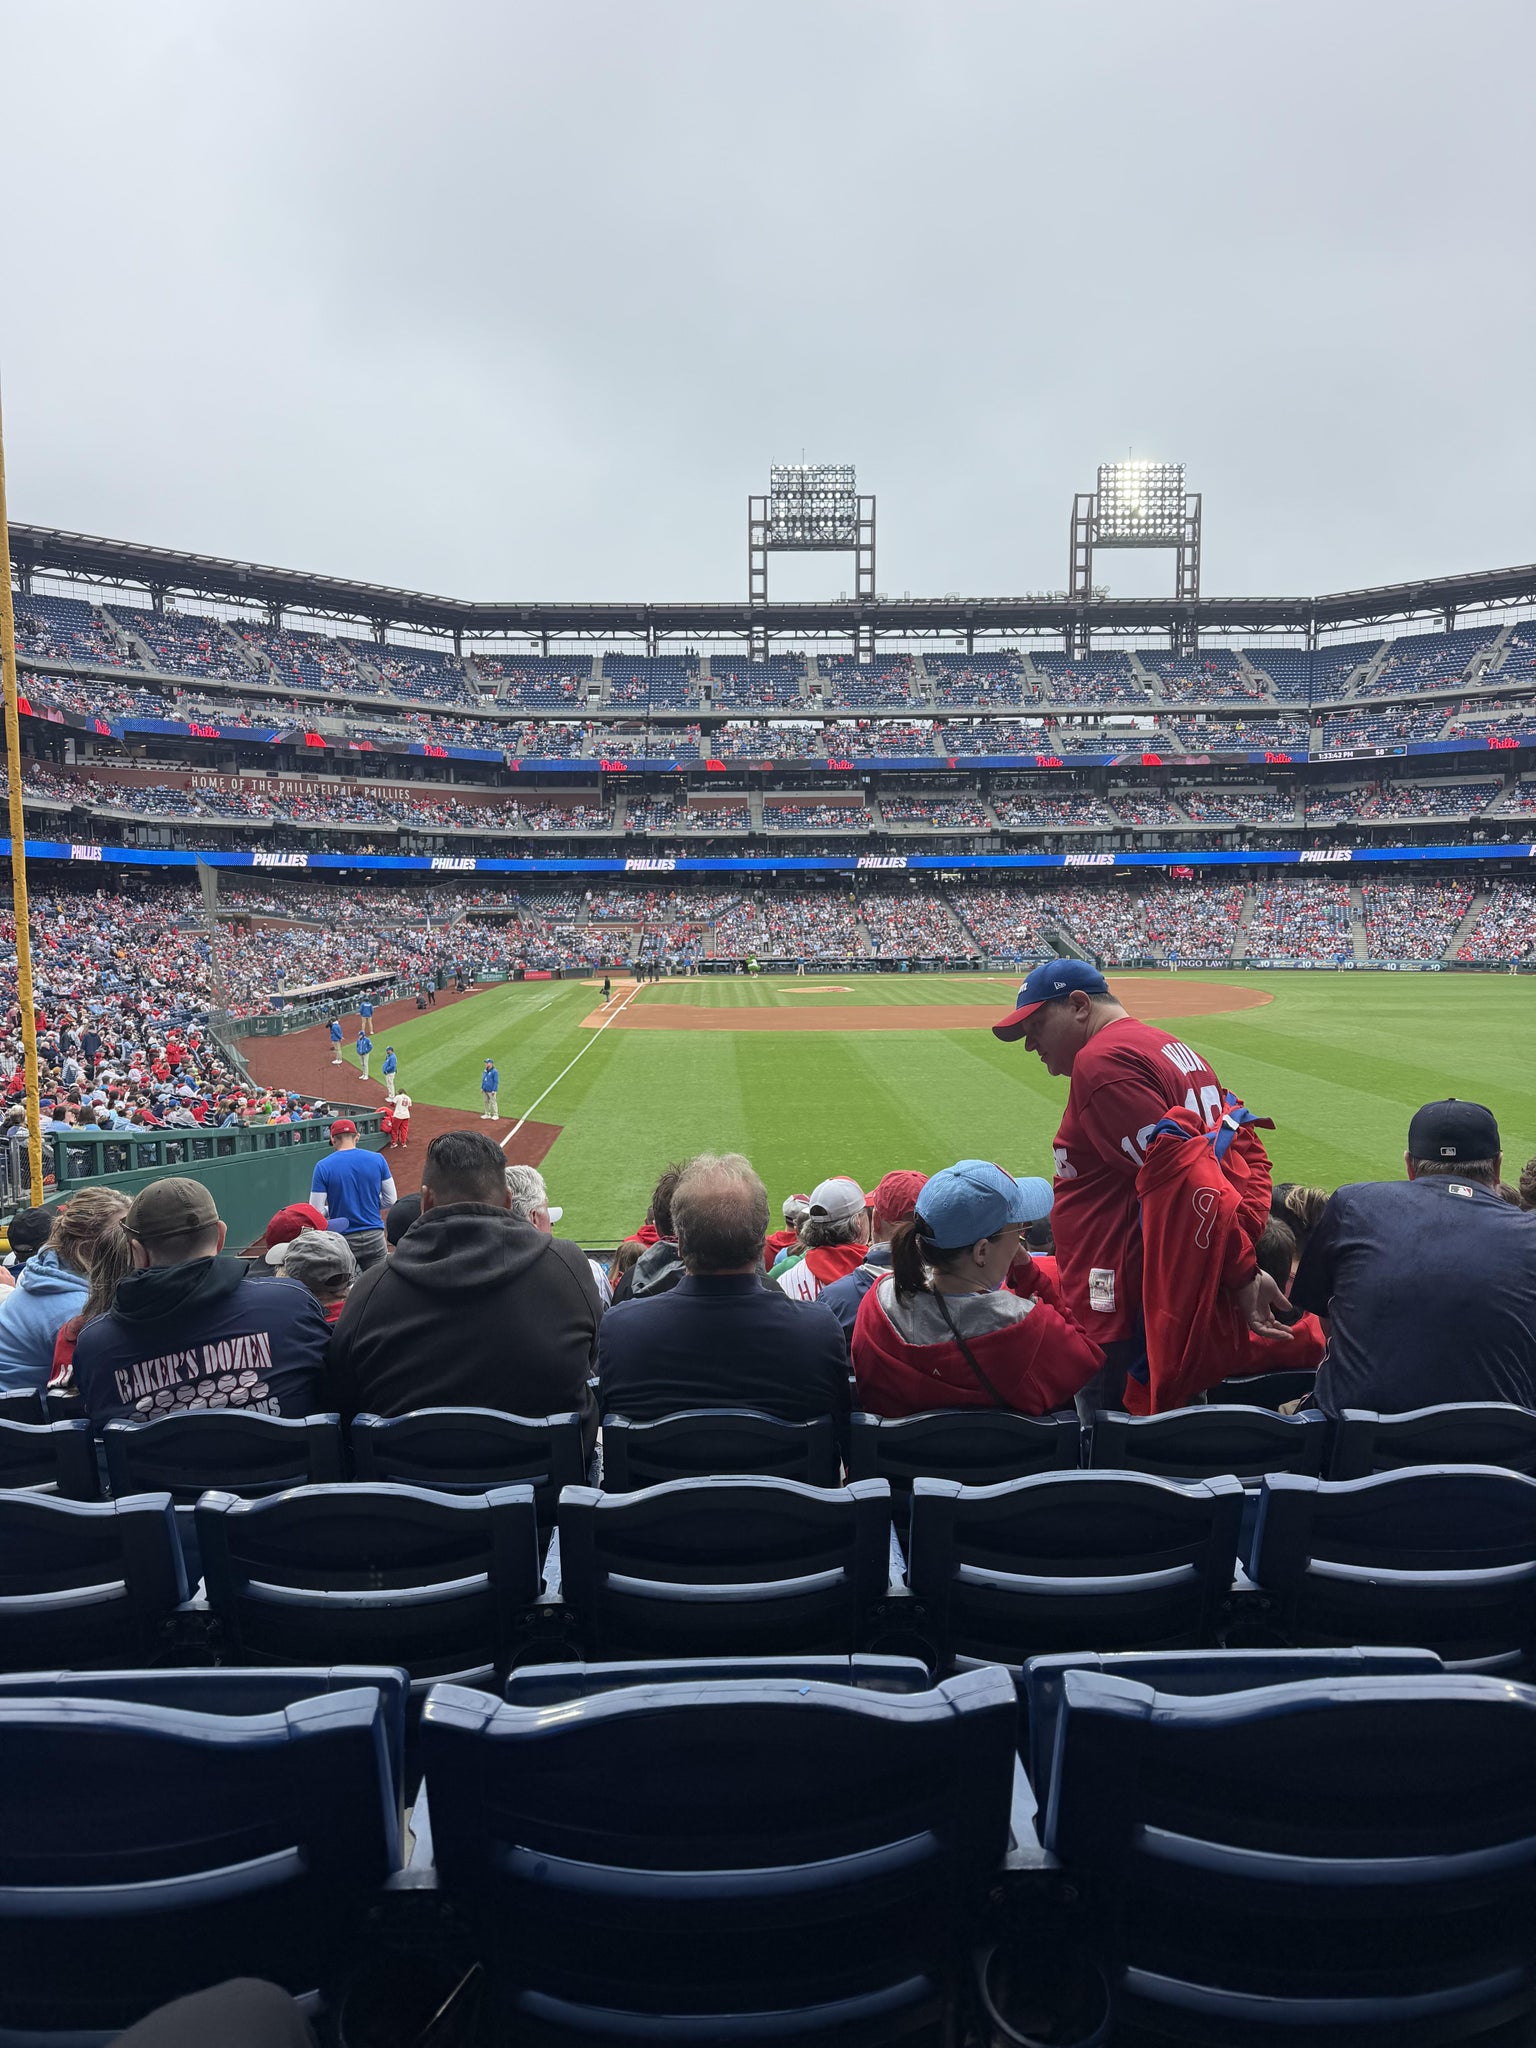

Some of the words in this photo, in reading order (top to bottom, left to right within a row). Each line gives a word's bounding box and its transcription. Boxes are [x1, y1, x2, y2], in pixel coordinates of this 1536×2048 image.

[191, 776, 225, 788] HOME
[231, 778, 245, 790] OF
[252, 779, 272, 792] THE
[279, 781, 357, 796] PHILADELPI
[71, 844, 102, 861] PHILLIES
[1299, 850, 1352, 862] PHILLIES
[253, 853, 308, 867] PHILLIES
[431, 858, 476, 870] PHILLIES
[625, 859, 676, 871] PHILLIES
[857, 857, 908, 868] PHILLIES
[1064, 854, 1115, 866] PHILLIES
[1344, 961, 1354, 969] 10
[203, 1331, 273, 1375] DOZEN
